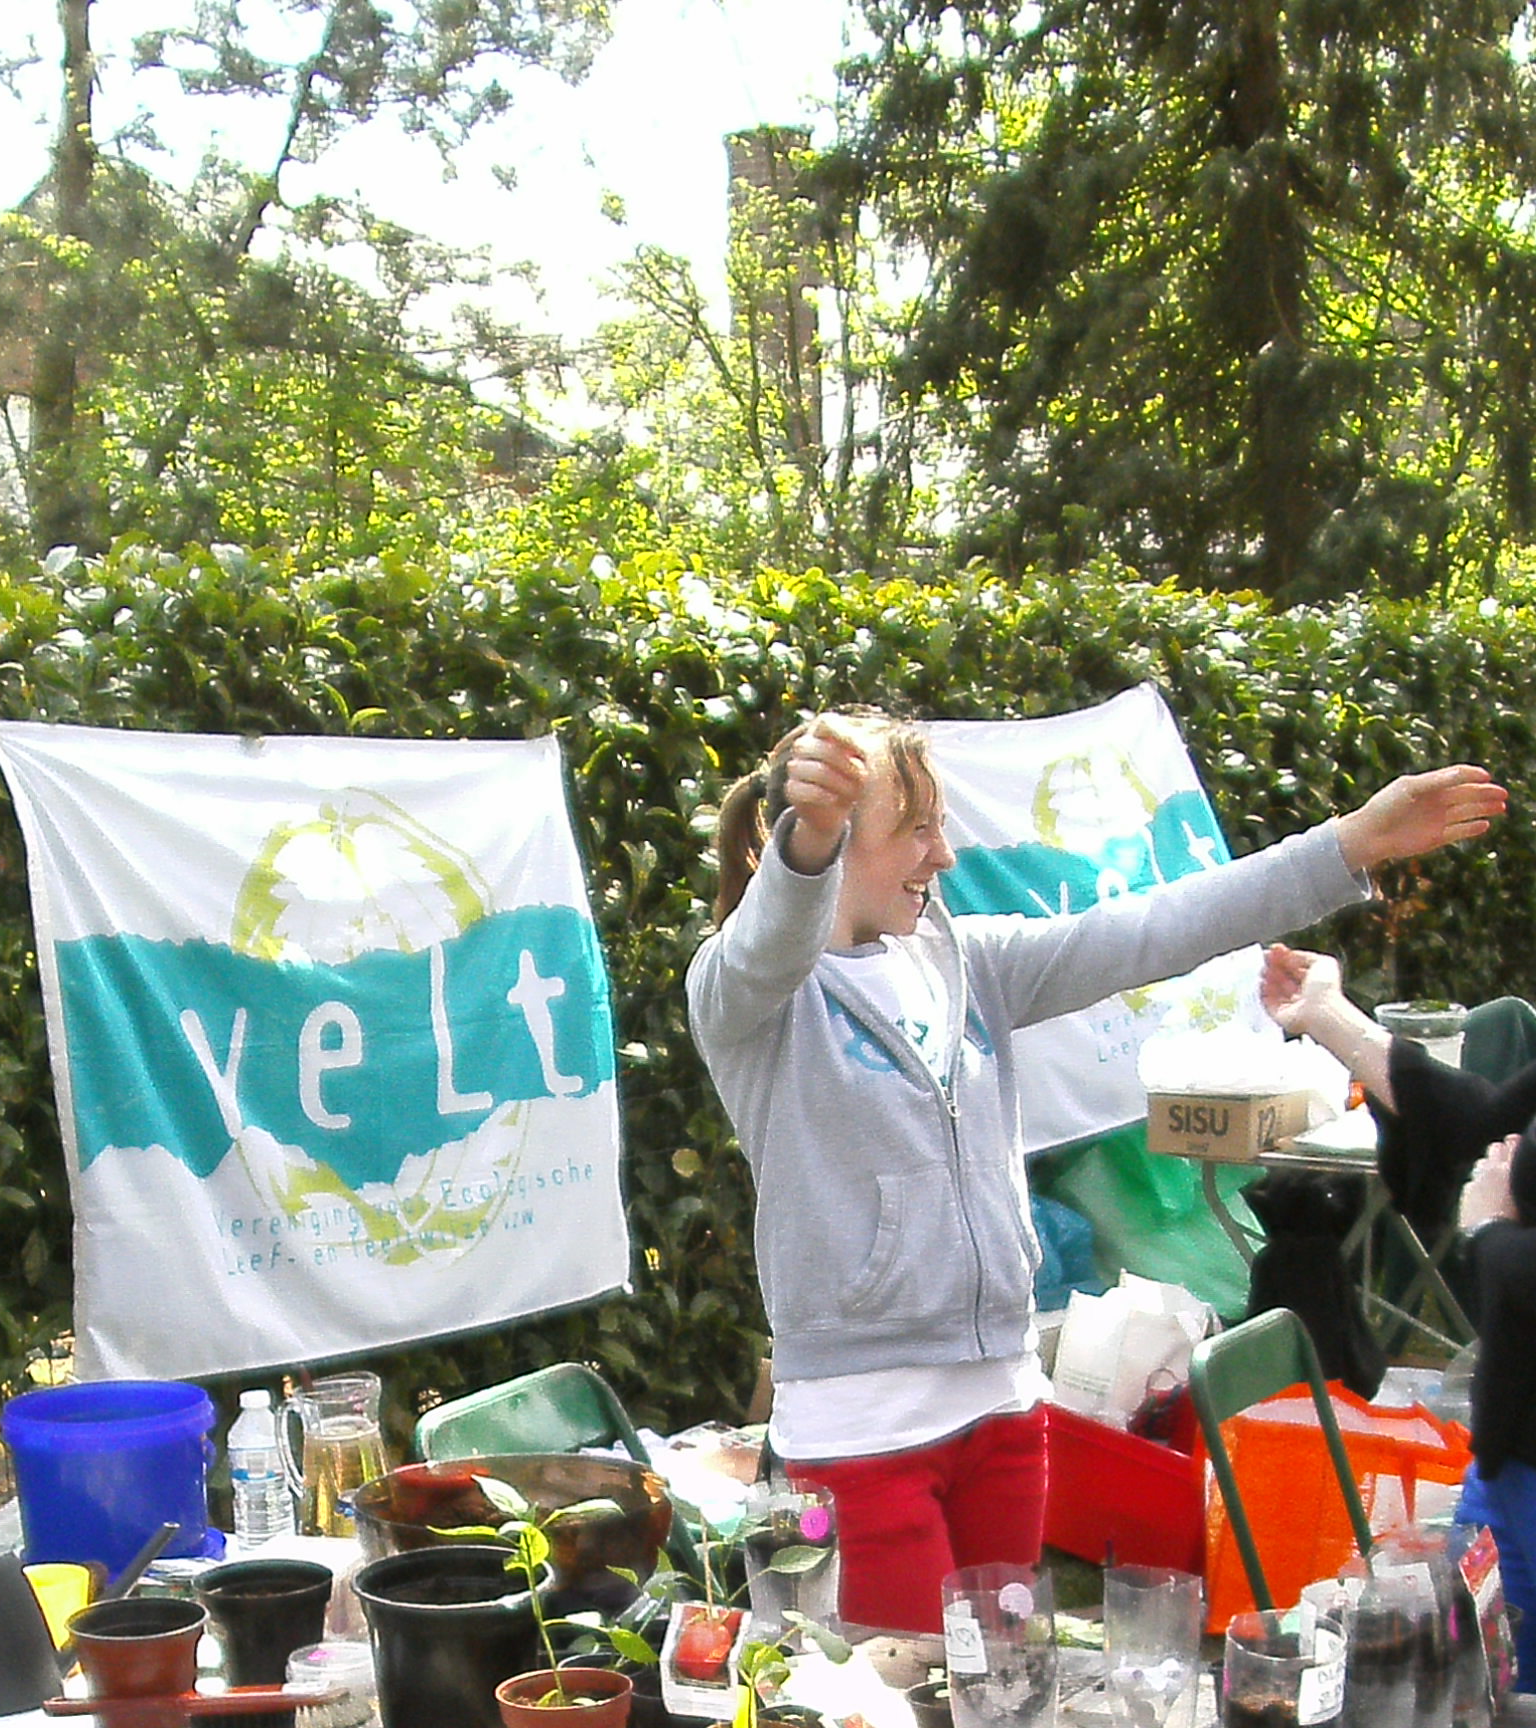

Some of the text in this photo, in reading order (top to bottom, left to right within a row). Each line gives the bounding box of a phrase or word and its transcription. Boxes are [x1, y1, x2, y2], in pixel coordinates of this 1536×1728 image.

[1168, 1103, 1231, 1137] SISU
[439, 1157, 594, 1208] Ecologische
[313, 1245, 339, 1266] en
